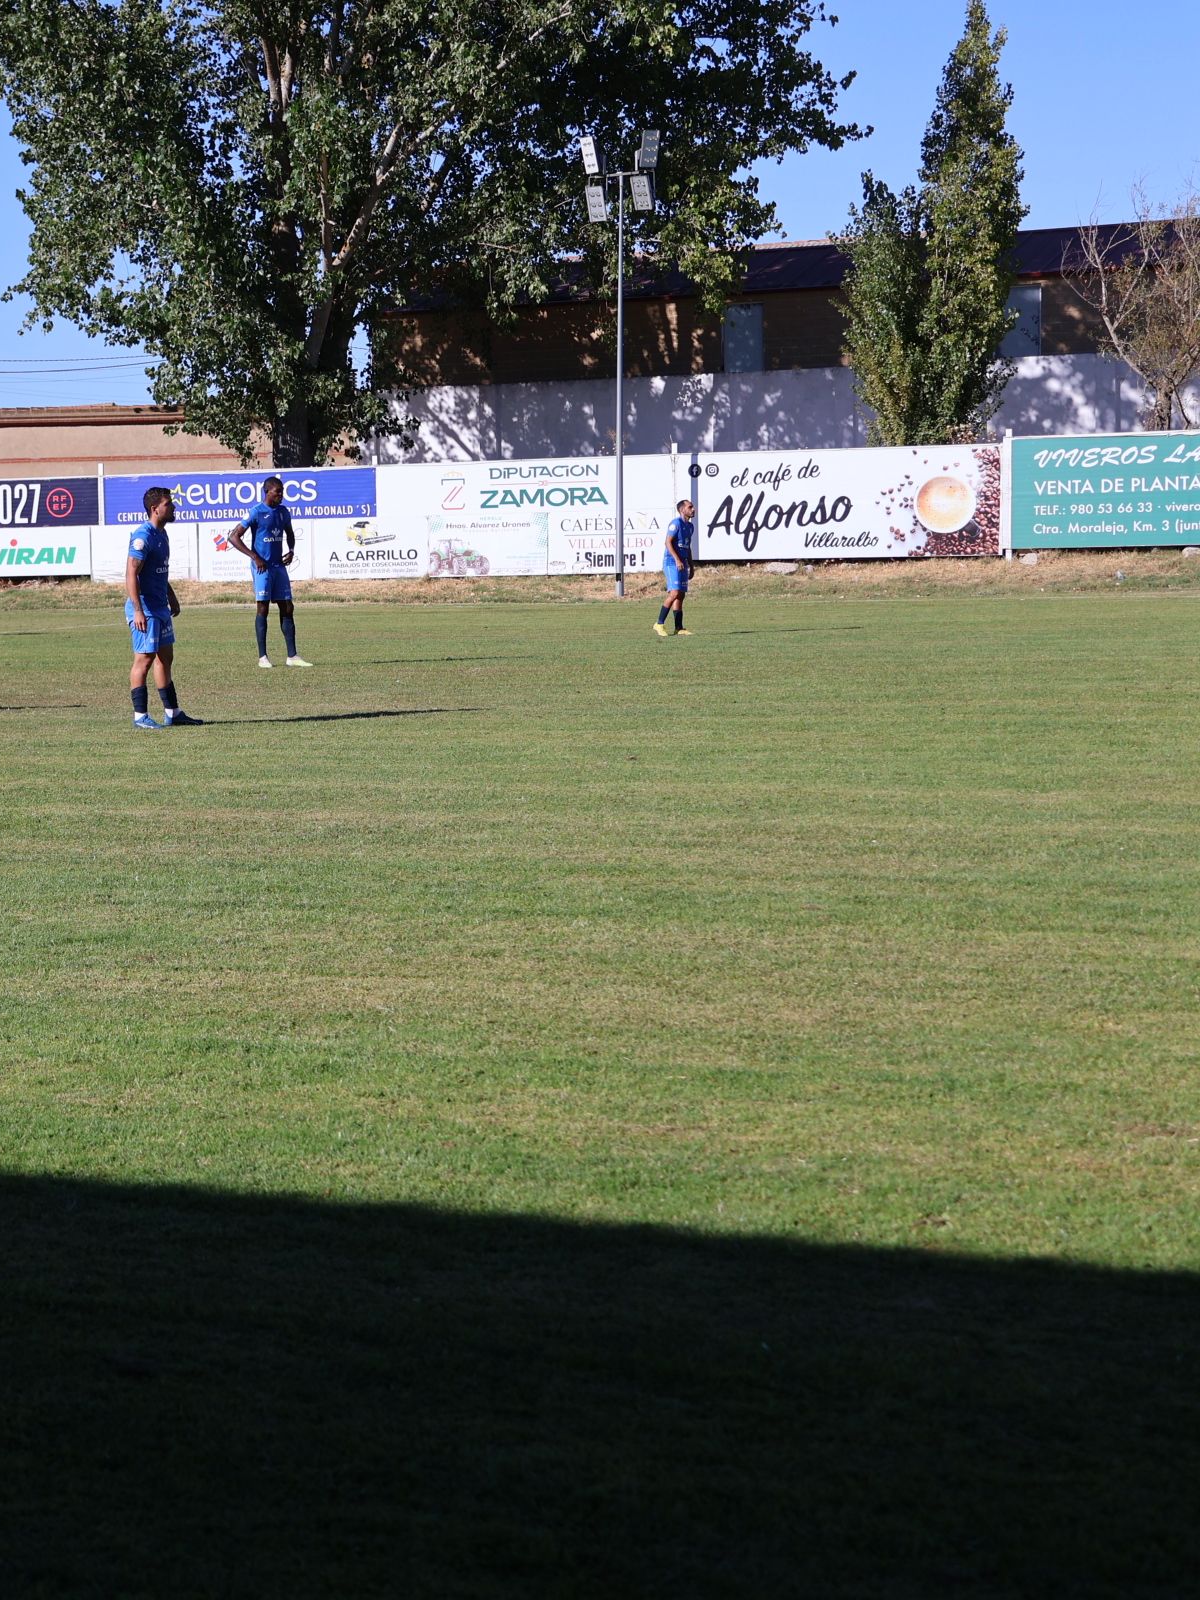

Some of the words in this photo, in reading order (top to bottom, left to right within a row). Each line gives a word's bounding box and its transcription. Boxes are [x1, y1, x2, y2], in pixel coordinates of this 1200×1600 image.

[1033, 445, 1158, 468] VIVEROS
[730, 467, 748, 488] el
[753, 462, 792, 491] café
[797, 458, 821, 479] de
[186, 474, 318, 506] eurocs
[1033, 478, 1094, 496] VENTA
[1101, 478, 1124, 493] DE
[480, 486, 608, 508] ZAMORA
[117, 511, 149, 522] CENTRO
[304, 505, 353, 516] MCDONALD
[1070, 504, 1094, 515] 980
[1097, 503, 1113, 514] 53
[1117, 502, 1133, 513] 66
[1137, 502, 1153, 513] 33
[560, 512, 660, 531] CAFÉSAÑA
[707, 491, 853, 552] Alfonso
[1033, 523, 1063, 534] Ctra.
[1067, 520, 1128, 536] Moraleja,
[1133, 520, 1157, 532] Km.
[1161, 520, 1170, 531] 3
[568, 537, 654, 549] VILLARLBO
[804, 532, 879, 548] Villaralbo
[329, 551, 341, 562] A.
[346, 549, 418, 561] CARRILLO
[585, 551, 636, 567] Siemre
